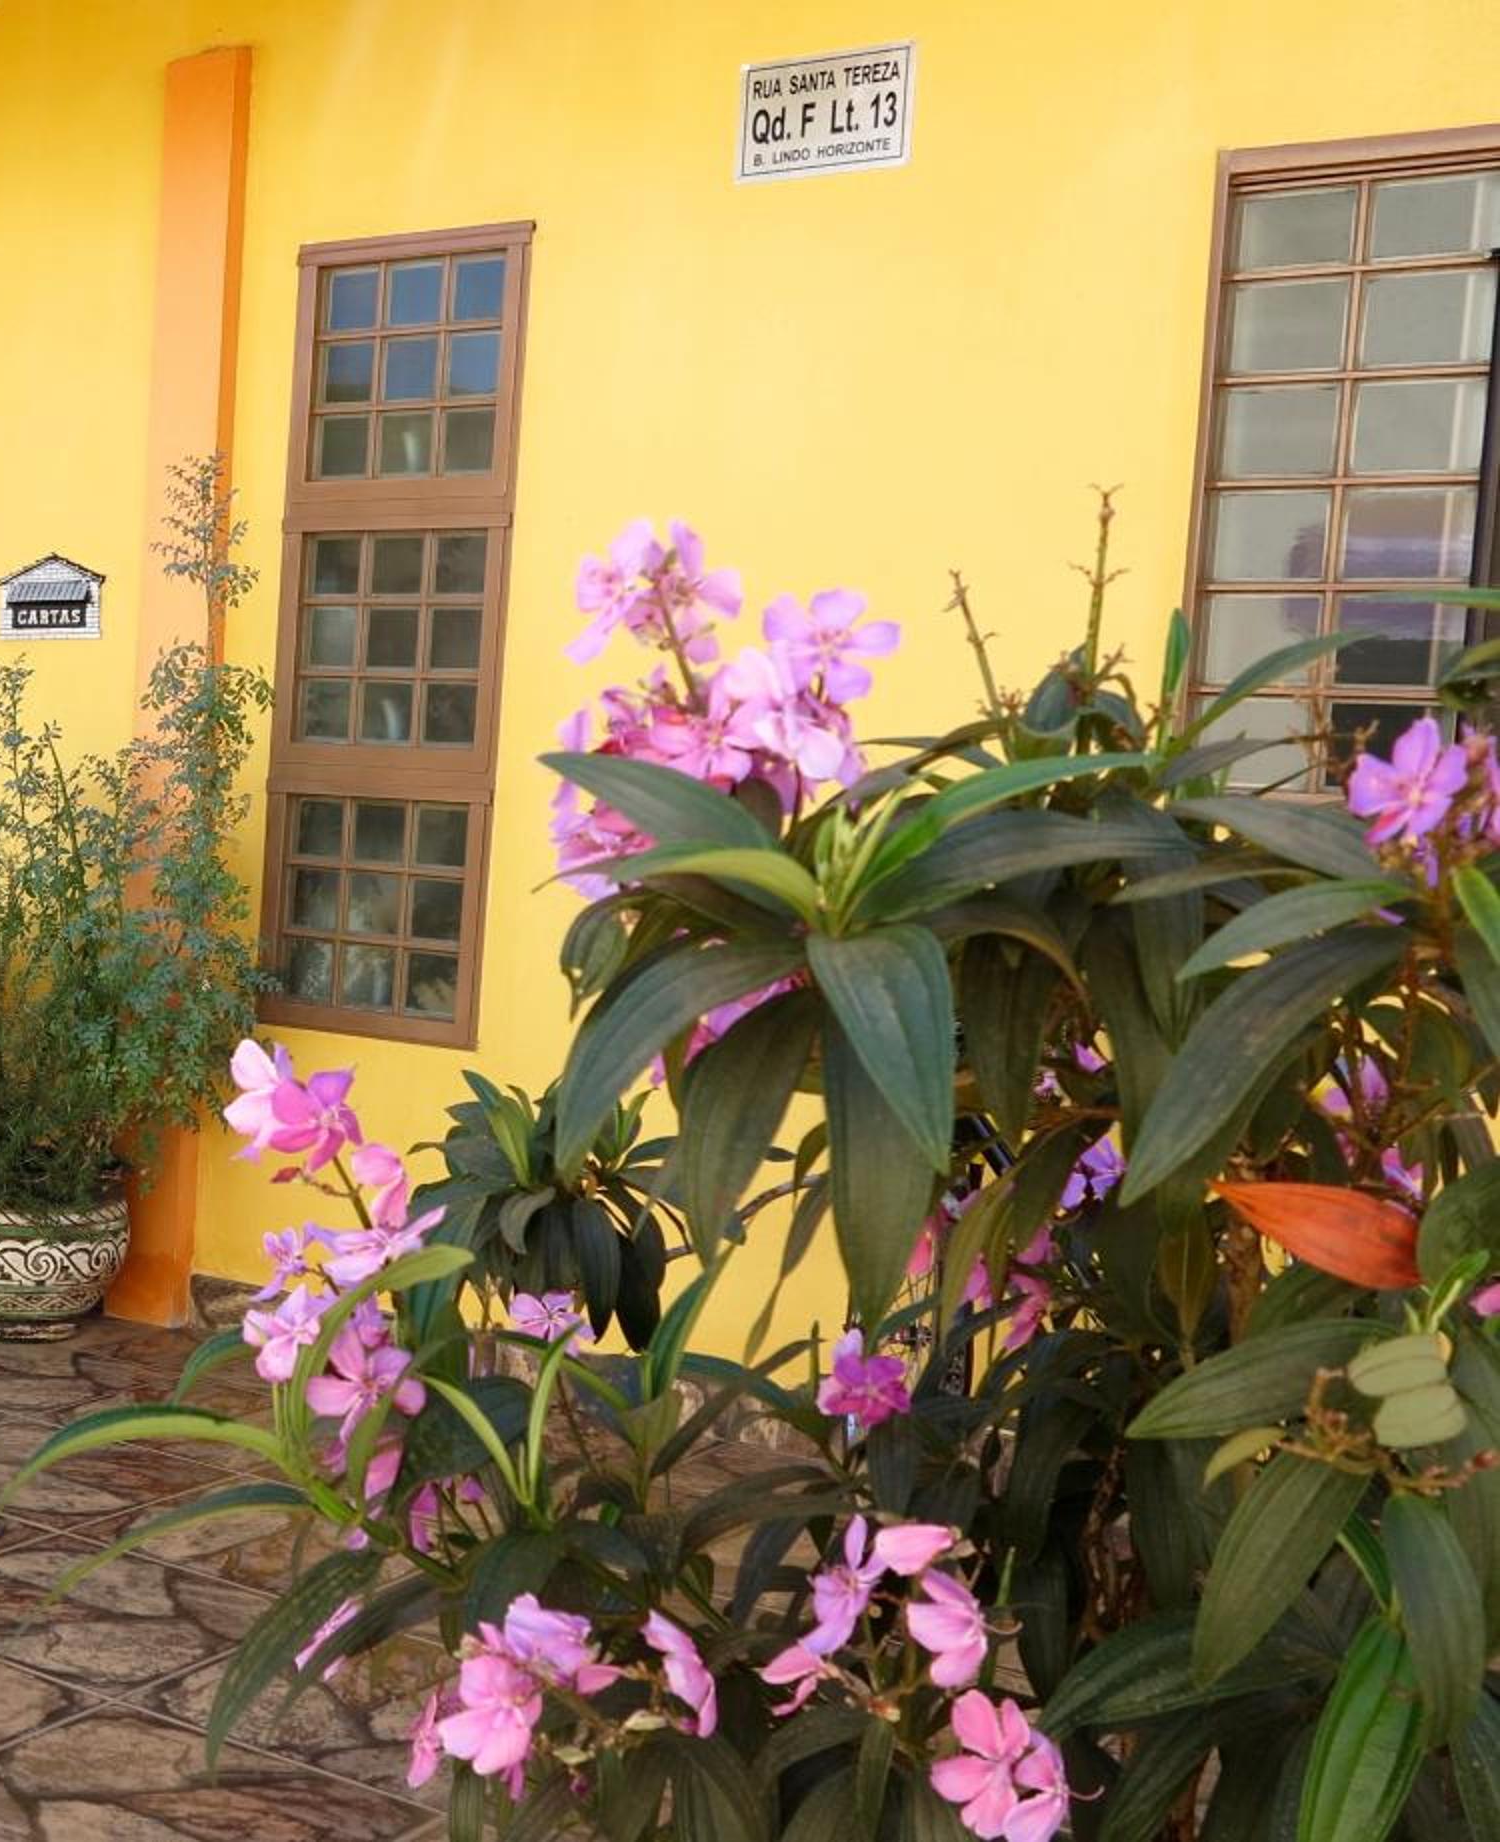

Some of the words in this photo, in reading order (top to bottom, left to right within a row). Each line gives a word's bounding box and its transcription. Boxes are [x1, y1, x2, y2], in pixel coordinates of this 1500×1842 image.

[753, 80, 782, 100] RUA
[789, 71, 836, 95] SANTA
[844, 61, 900, 87] TEREZA
[752, 106, 791, 145] Qd.
[800, 102, 816, 138] F
[830, 100, 859, 134] Lt.
[870, 91, 897, 128] 13
[772, 148, 810, 165] LINDO
[817, 138, 891, 159] HORIZONTE
[17, 609, 80, 625] CARTAS
